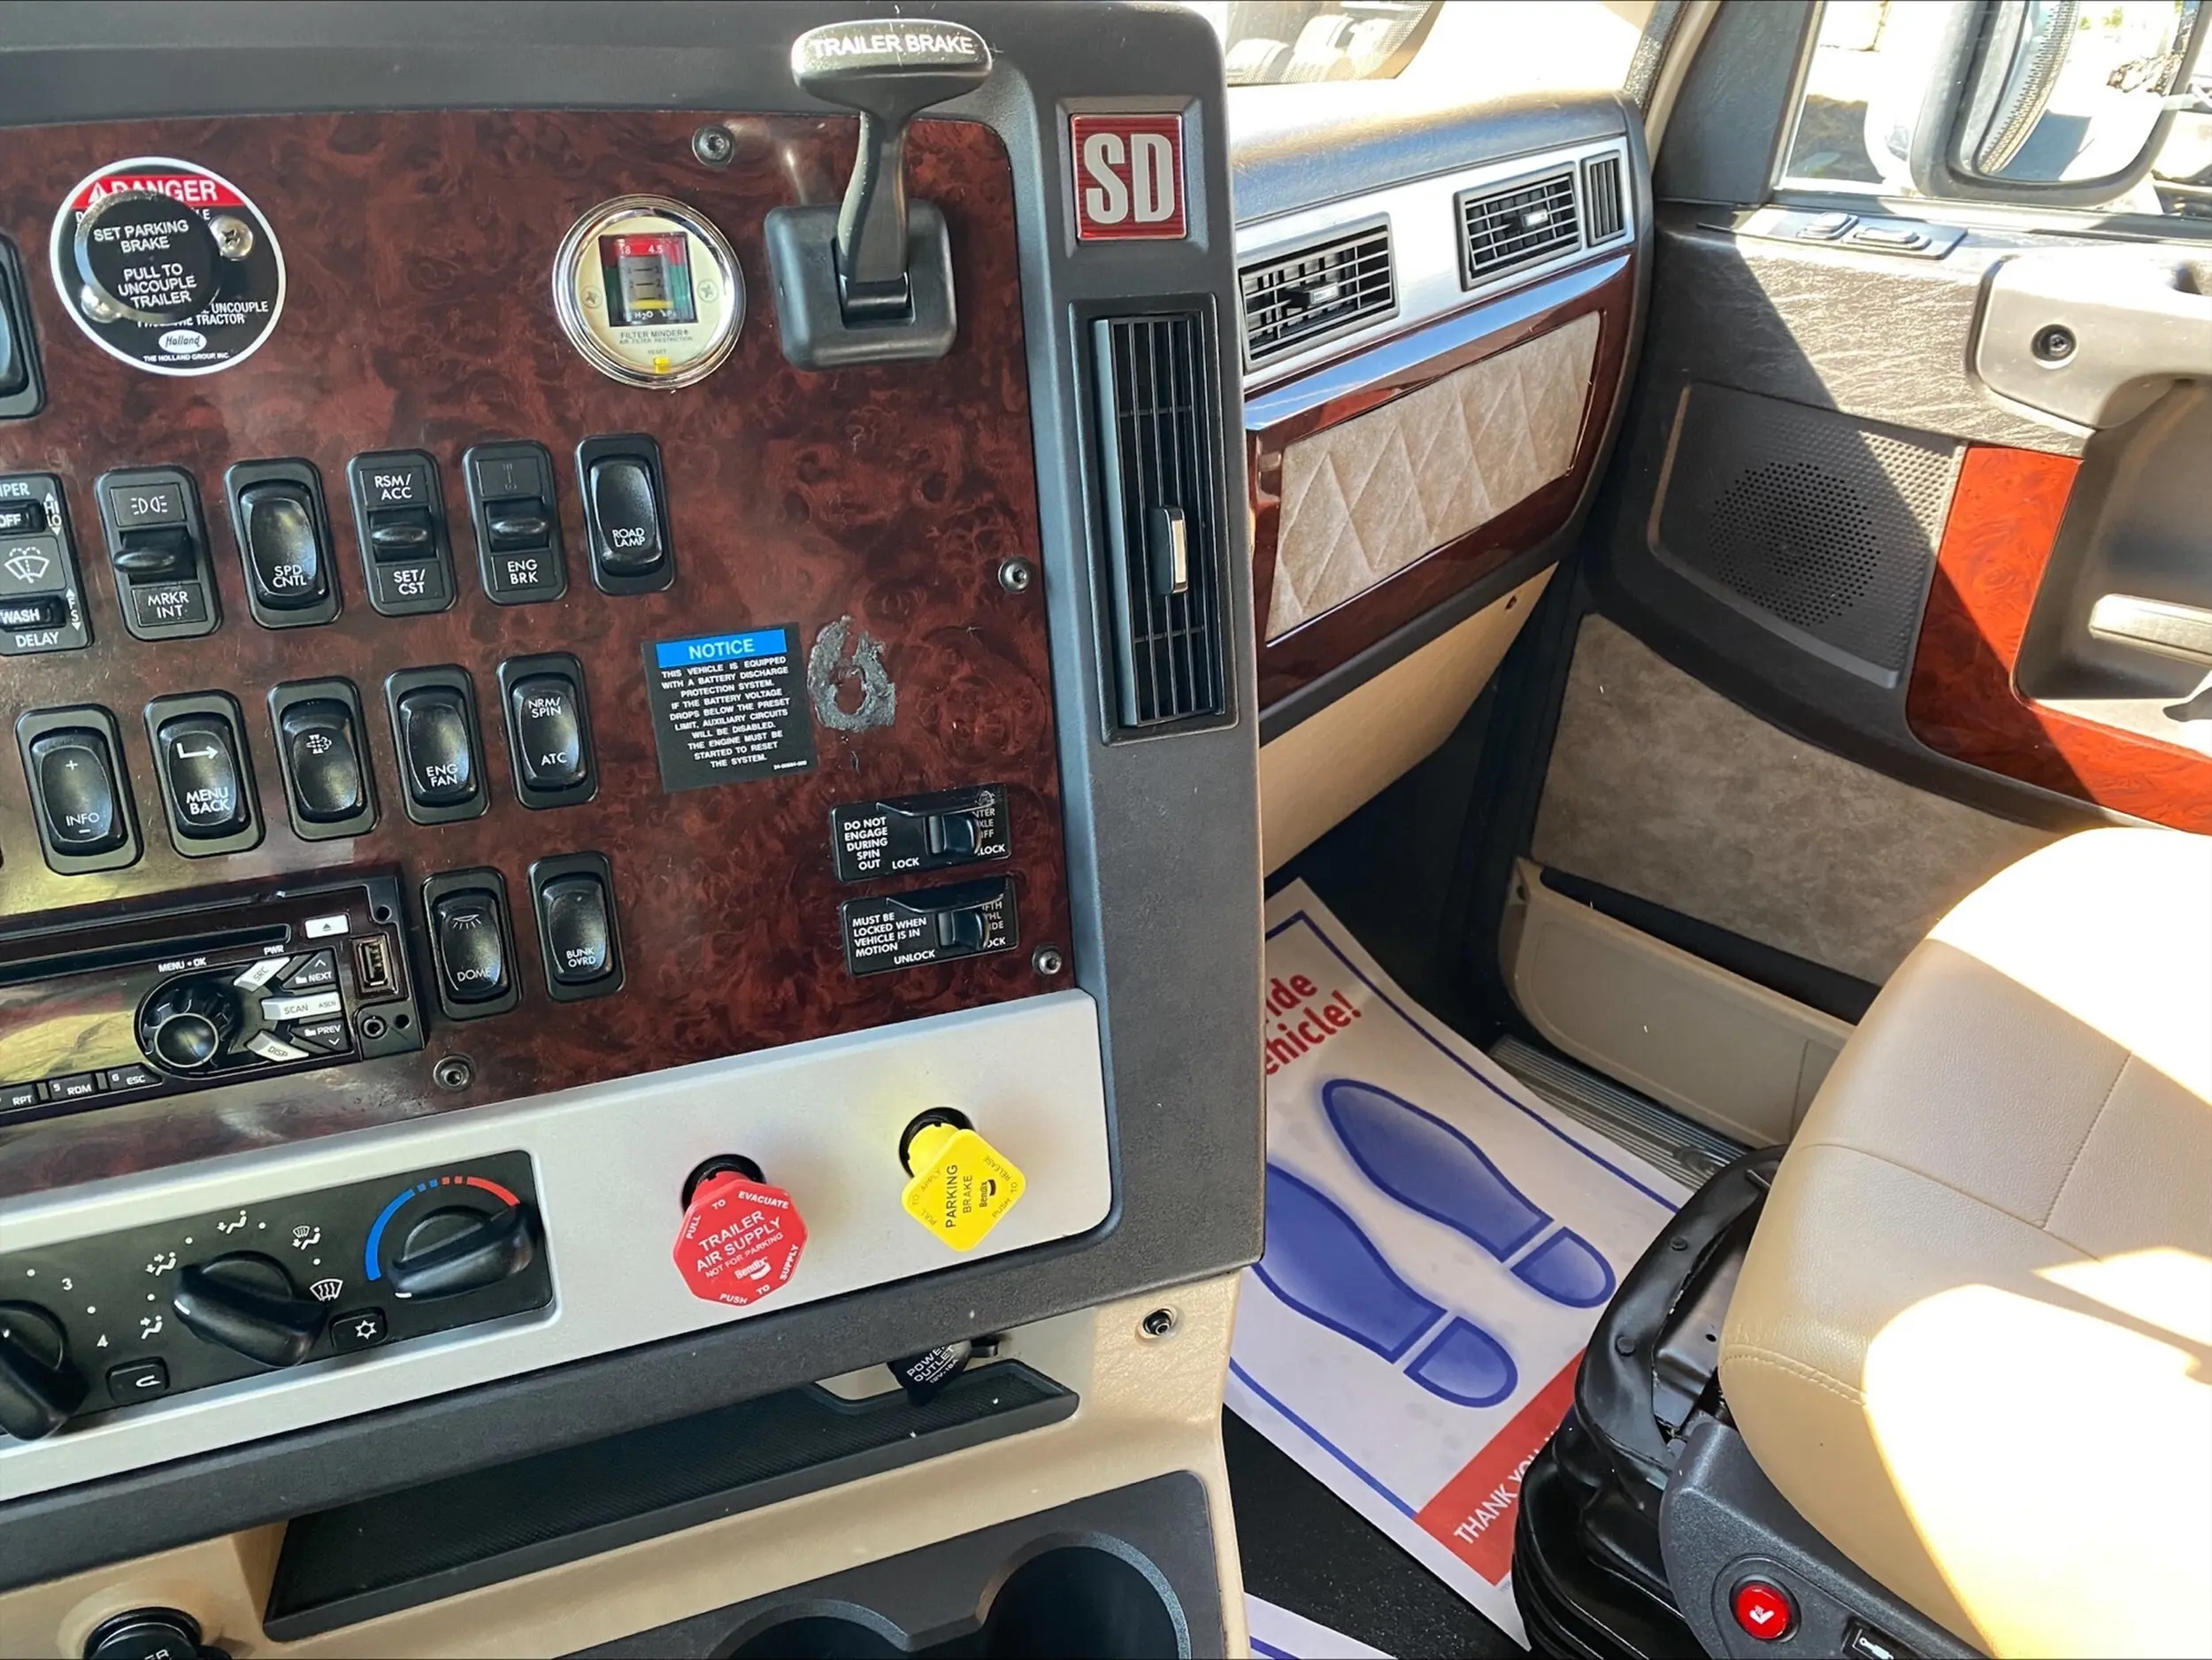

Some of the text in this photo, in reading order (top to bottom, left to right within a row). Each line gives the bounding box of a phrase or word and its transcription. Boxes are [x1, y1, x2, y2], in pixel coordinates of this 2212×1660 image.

[812, 33, 977, 57] TRAILER BRAKE
[1082, 132, 1176, 225] SD
[94, 219, 189, 242] SET PARKING
[120, 235, 171, 254] BRAKE
[123, 262, 183, 282] PULL TO
[118, 275, 197, 296] UNCOUPLE
[130, 290, 192, 310] TRAILER
[211, 300, 269, 314] UNCOUPLE
[196, 312, 246, 326] TRACTOR
[165, 334, 202, 349] Holland
[620, 330, 649, 341] FILTER
[654, 334, 694, 344] RESTRICTION
[157, 353, 191, 363] HOLLAND
[374, 473, 411, 488] RSM/
[380, 486, 412, 501] ACC
[43, 500, 59, 515] HI
[46, 514, 62, 527] LO
[611, 526, 645, 540] ROAD
[614, 535, 646, 548] LAMP
[273, 564, 303, 577] SPD
[507, 558, 538, 573] ENG
[273, 575, 307, 588] CNTL
[394, 568, 426, 584] SET/
[510, 571, 539, 585] BRK
[398, 580, 426, 596] CST
[148, 589, 189, 607] MRKR
[0, 607, 41, 626] WASH
[71, 612, 80, 623] S
[156, 604, 184, 619] INT
[15, 631, 60, 648] DELAY
[687, 638, 756, 660] NOTICE
[661, 656, 787, 679] THIS VEHICLE IS EQUIPPED
[661, 680, 684, 690] WITH
[698, 672, 736, 686] BATTERY
[740, 666, 789, 680] DISCHARGE
[680, 684, 735, 698] PROTECTION
[528, 696, 561, 710] NRM/
[682, 699, 700, 710] THE
[703, 694, 741, 706] BATTERY
[744, 688, 782, 700] VOLTAGE
[531, 705, 562, 719] SPIN
[669, 697, 791, 721] DROPS BELOW THE PRESET
[703, 713, 746, 728] AUXILIARY
[749, 708, 788, 721] CIRCUITS
[691, 721, 776, 740] WILL BE DISABLED.
[687, 730, 784, 751] THE ENGINE MUST BE
[694, 741, 779, 761] STARTED TO RESET
[541, 752, 567, 766] ATC
[710, 758, 728, 769] THE
[426, 763, 458, 778] ENG
[430, 773, 458, 788] FAN
[186, 787, 229, 804] MENU
[189, 799, 231, 816] BACK
[972, 807, 995, 819] NTER
[65, 811, 100, 827] INFO
[843, 816, 887, 832] DO NOT
[977, 818, 995, 829] XLE
[844, 827, 888, 842] ENGAGE
[847, 838, 888, 852] DURING
[856, 849, 881, 861] SPIN
[858, 859, 881, 872] OUT
[892, 857, 920, 870] LOCK
[852, 911, 895, 927] MUST BE
[853, 917, 927, 938] LOCKED WHEN
[854, 928, 921, 948] VEHICLE IS IN
[987, 936, 1006, 949] OCK
[264, 944, 285, 955] PWR
[565, 947, 595, 959] BUNK
[855, 942, 899, 957] MOTION
[894, 949, 936, 965] UNLOCK
[157, 957, 207, 972] MENU OK
[568, 955, 596, 967] OVRD
[253, 966, 269, 982] SRC
[308, 971, 333, 982] NEXT
[456, 967, 492, 982] DOME
[283, 1004, 309, 1015] SCAN
[317, 1024, 342, 1035] PREV
[1265, 989, 1362, 1076] ehicle!
[267, 1045, 288, 1058] DISP
[126, 1075, 146, 1086] ESC
[53, 1083, 92, 1096] 5 RDM
[12, 1095, 33, 1106] RPT
[982, 1154, 1011, 1182] RELEASE
[945, 1164, 958, 1228] PARKING
[963, 1174, 973, 1214] BRAKE
[979, 1181, 988, 1208] Bendix
[685, 1190, 790, 1240] PULL TO EVACUATE
[991, 1197, 1012, 1218] PUSH
[698, 1210, 765, 1252] TRAILER
[695, 1215, 781, 1272] AIR SUPPLY
[705, 1232, 784, 1279] NOT FOR PARKING
[719, 1243, 799, 1304] PUSH TO SUPPLY
[62, 1278, 73, 1291] 3
[96, 1334, 108, 1348] 4
[906, 1346, 945, 1377] POWE
[914, 1344, 955, 1382] OUTLET
[1452, 1448, 1540, 1544] THANK YO
